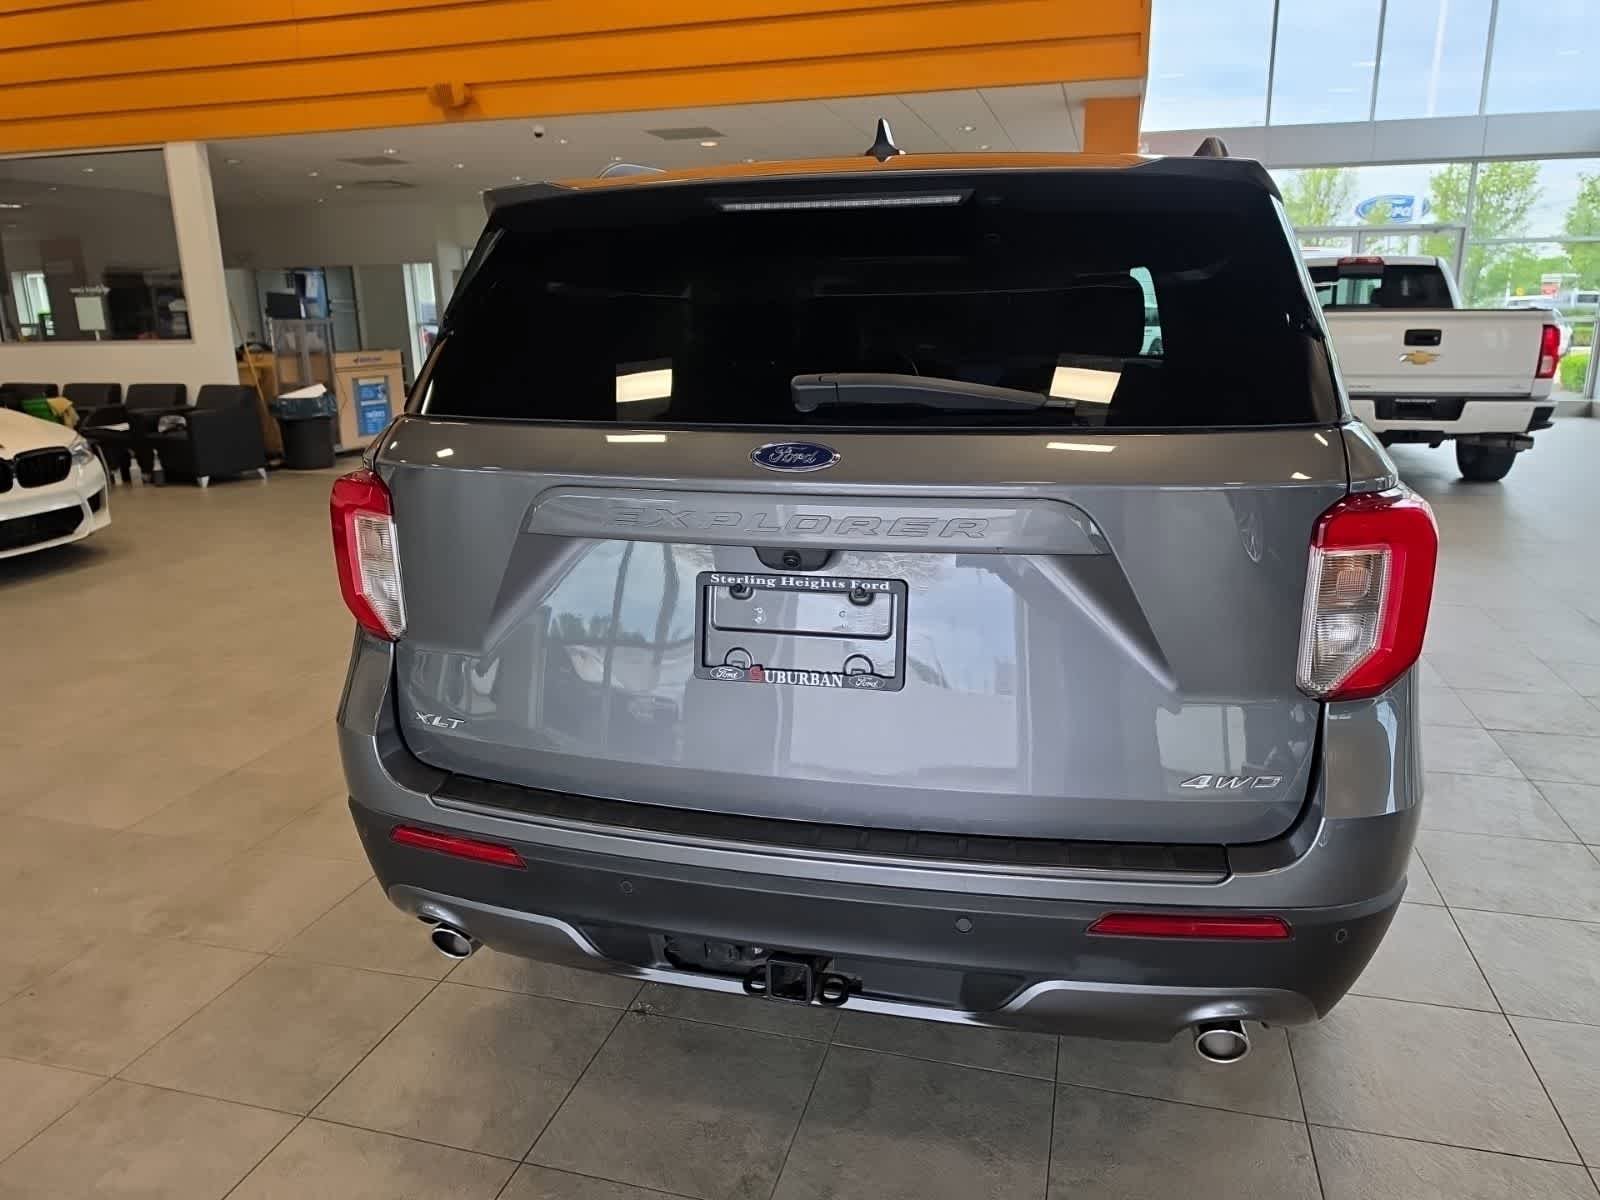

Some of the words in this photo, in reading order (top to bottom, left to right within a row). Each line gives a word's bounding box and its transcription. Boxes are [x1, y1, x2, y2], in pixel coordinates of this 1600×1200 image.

[768, 445, 819, 464] Ford
[607, 507, 990, 539] EXPLORER
[710, 573, 776, 588] Sterling
[780, 576, 846, 590] Heights
[850, 579, 890, 591] Ford
[715, 667, 739, 680] Ford
[749, 665, 843, 688] SUBURBAN
[854, 676, 879, 688] Ford
[415, 711, 465, 729] XLT
[1180, 774, 1282, 789] 4WD
